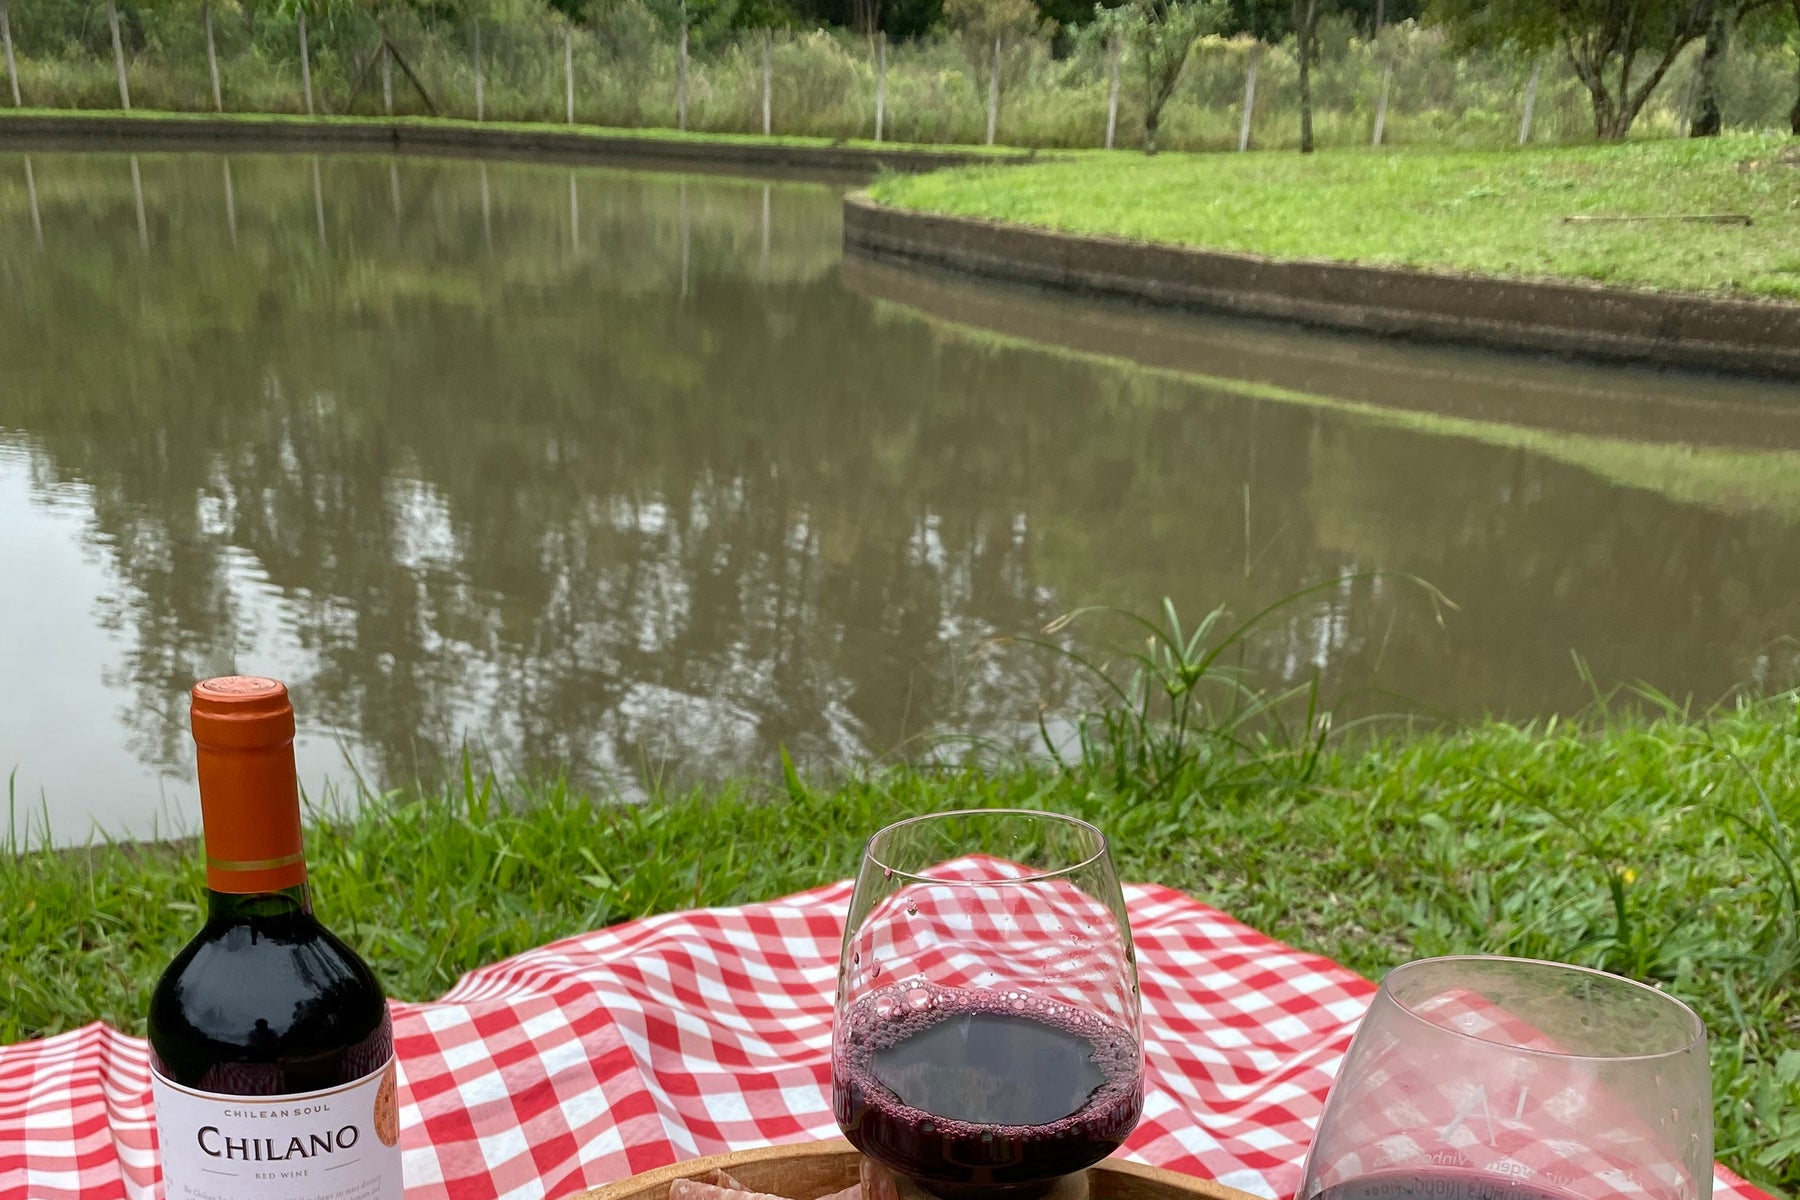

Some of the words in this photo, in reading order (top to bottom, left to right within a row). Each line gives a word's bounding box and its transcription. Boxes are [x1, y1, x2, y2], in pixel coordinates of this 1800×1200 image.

[224, 1109, 289, 1119] CHILEAN
[294, 1104, 331, 1117] SOUL
[197, 1124, 361, 1162] CHILANO
[255, 1172, 277, 1181] RED
[280, 1170, 309, 1179] WINE
